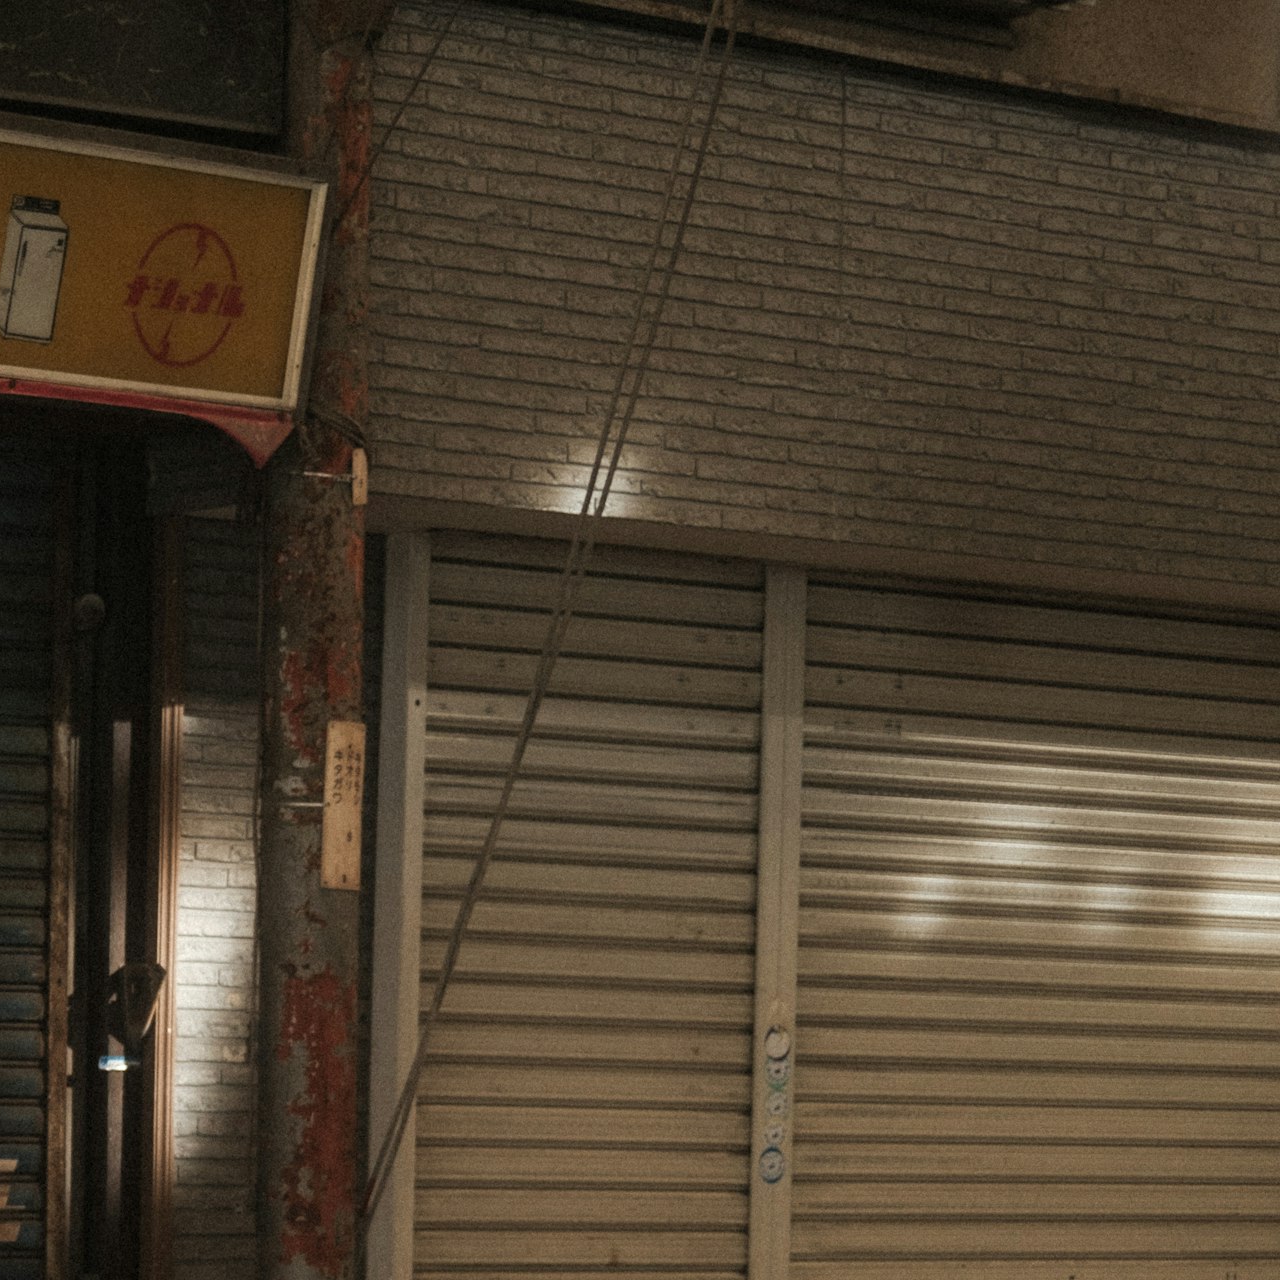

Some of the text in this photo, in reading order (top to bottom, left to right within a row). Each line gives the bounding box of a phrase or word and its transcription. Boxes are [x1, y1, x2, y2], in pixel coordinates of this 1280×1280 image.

[126, 275, 245, 317] ナショナル
